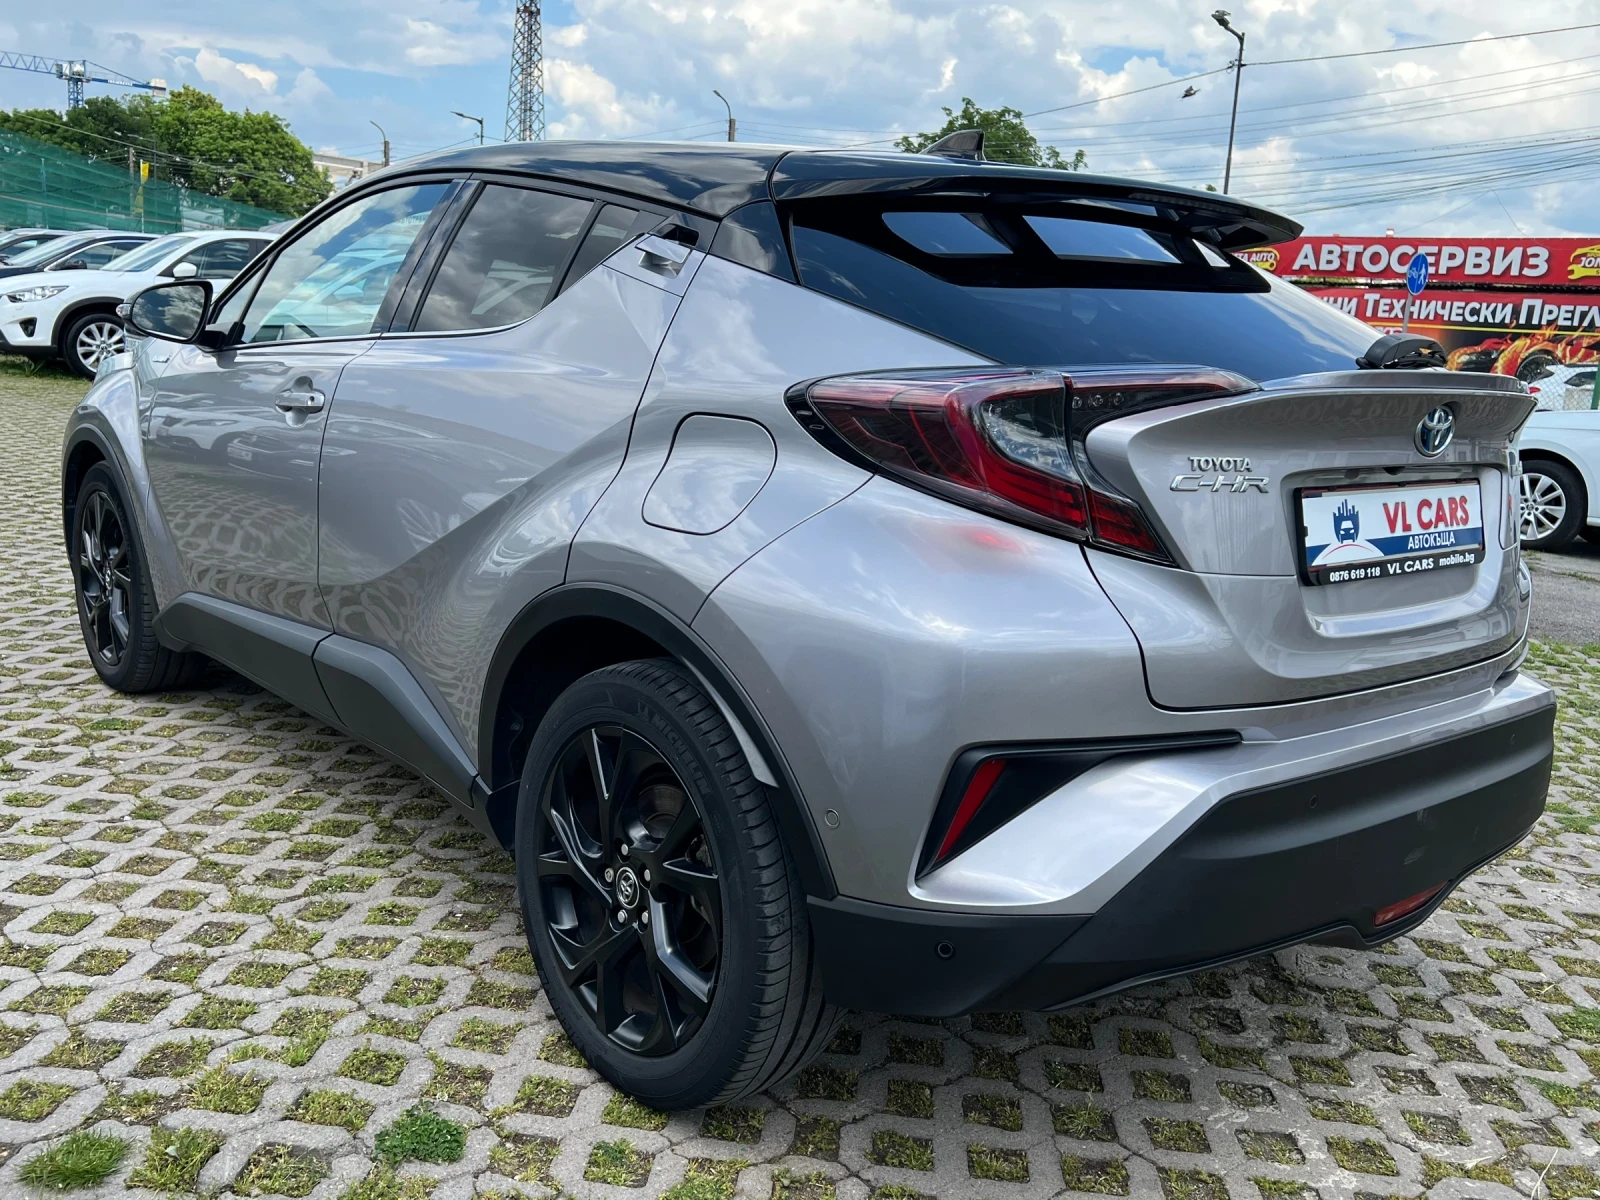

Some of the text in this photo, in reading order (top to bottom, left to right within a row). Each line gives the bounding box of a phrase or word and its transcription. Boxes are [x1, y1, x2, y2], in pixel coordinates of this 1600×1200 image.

[1250, 252, 1275, 262] AUTO
[1292, 244, 1549, 277] АВТОСЕРВИЗ
[1188, 457, 1252, 472] TOYOTA
[1169, 474, 1270, 493] C-HR
[1383, 495, 1469, 533] VL CARS
[1407, 531, 1455, 550] АВТОКЪЩА
[1329, 552, 1475, 582] 0876 619 118 VL CARS mobile.bg
[650, 713, 712, 795] MICHELIN
